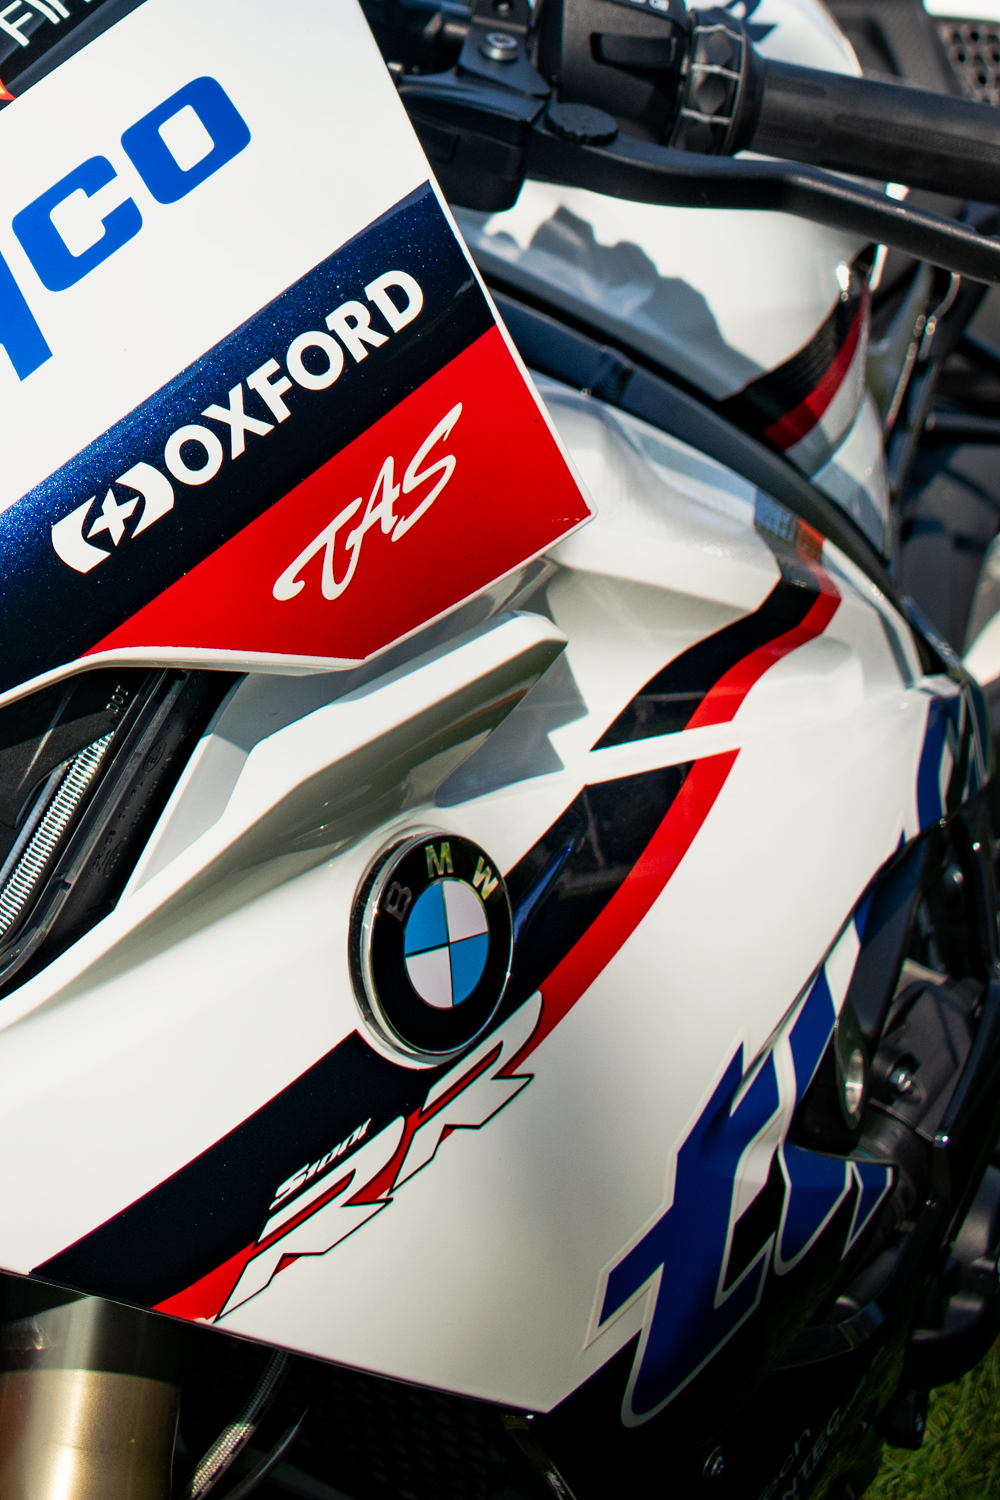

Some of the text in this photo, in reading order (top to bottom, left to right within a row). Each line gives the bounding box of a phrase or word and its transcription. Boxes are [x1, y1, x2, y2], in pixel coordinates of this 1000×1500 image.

[164, 270, 424, 485] OXFORD
[272, 401, 463, 602] TAS
[105, 684, 129, 715] DOT
[384, 841, 499, 922] BMW
